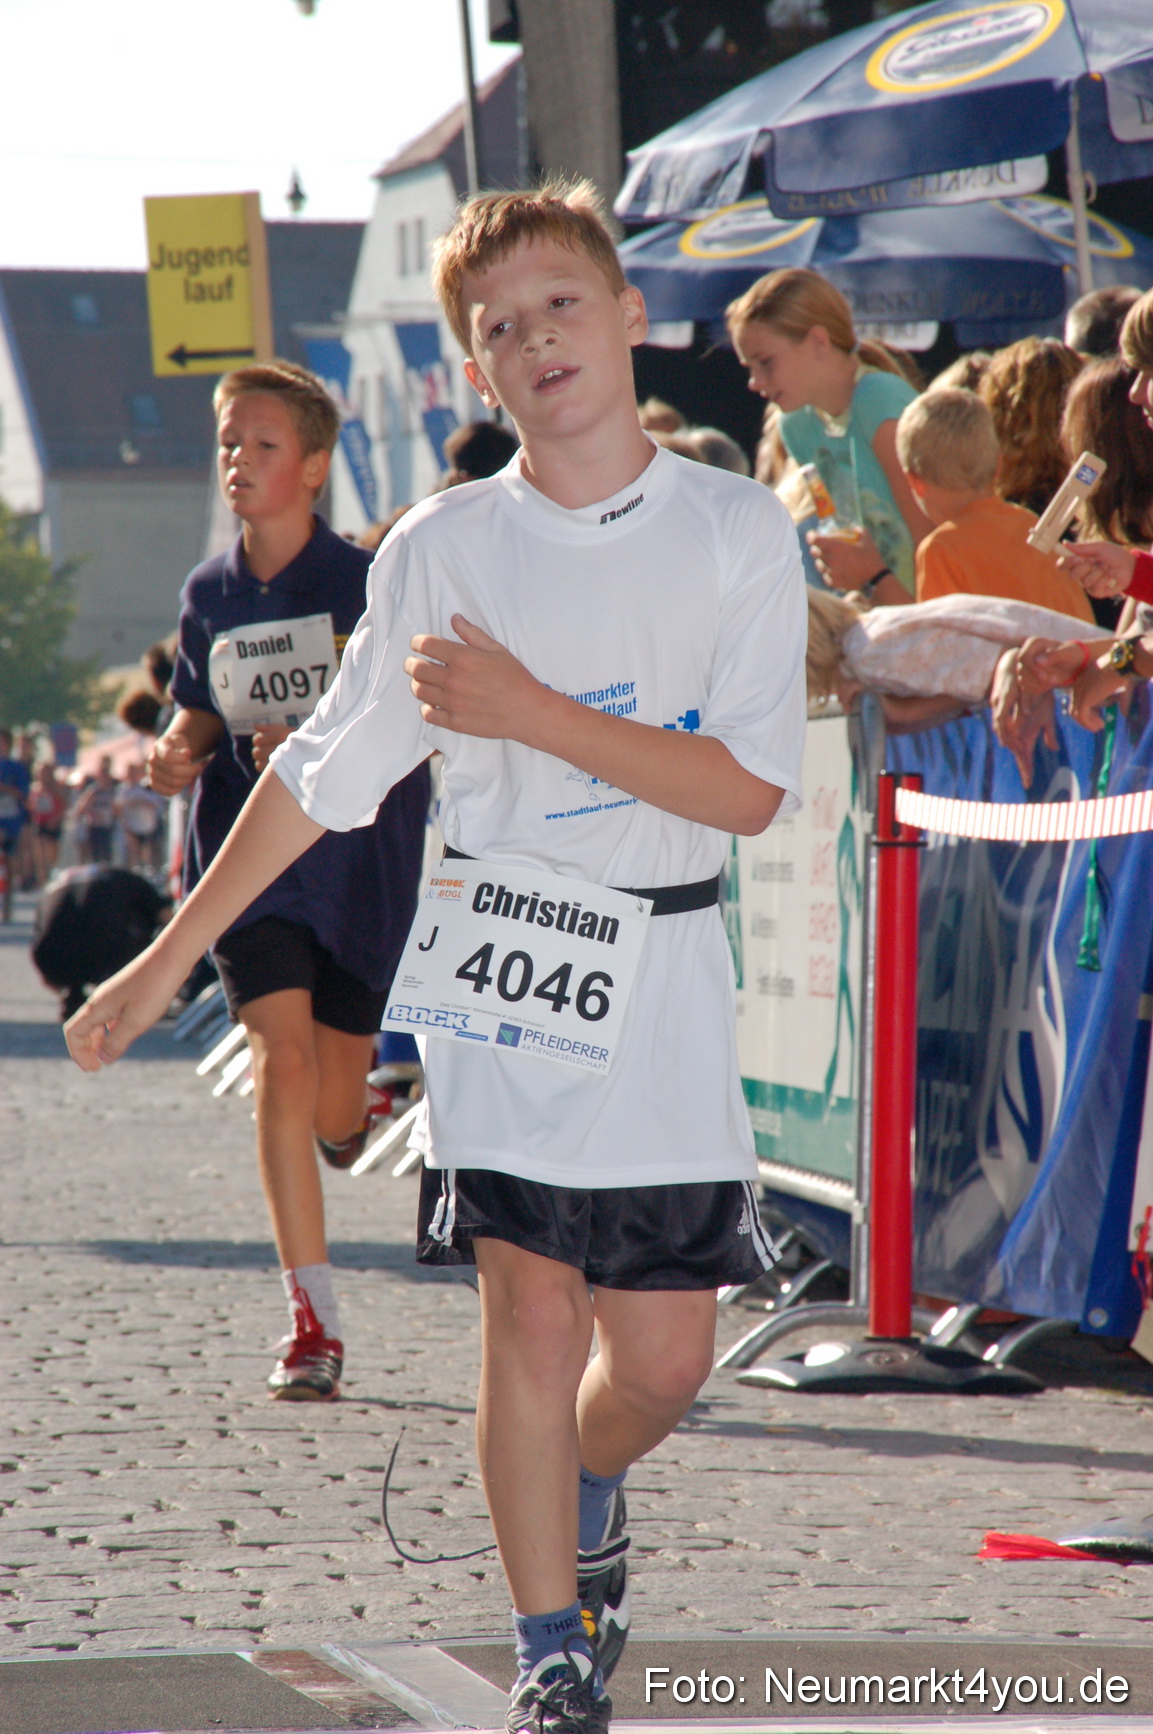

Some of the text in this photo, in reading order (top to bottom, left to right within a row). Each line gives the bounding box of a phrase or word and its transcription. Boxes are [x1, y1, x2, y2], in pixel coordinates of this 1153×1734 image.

[183, 274, 234, 303] lauf
[236, 633, 294, 659] Daniel
[220, 672, 229, 689] J
[249, 663, 329, 704] 4097
[568, 682, 635, 705] umarkter
[471, 882, 620, 945] Christian
[418, 926, 439, 952] J
[455, 942, 614, 1022] 4046
[387, 1004, 470, 1030] BOCK
[521, 1044, 607, 1071] AKTIENGESELLSCHAFT
[523, 1029, 609, 1062] PFLEIDERER
